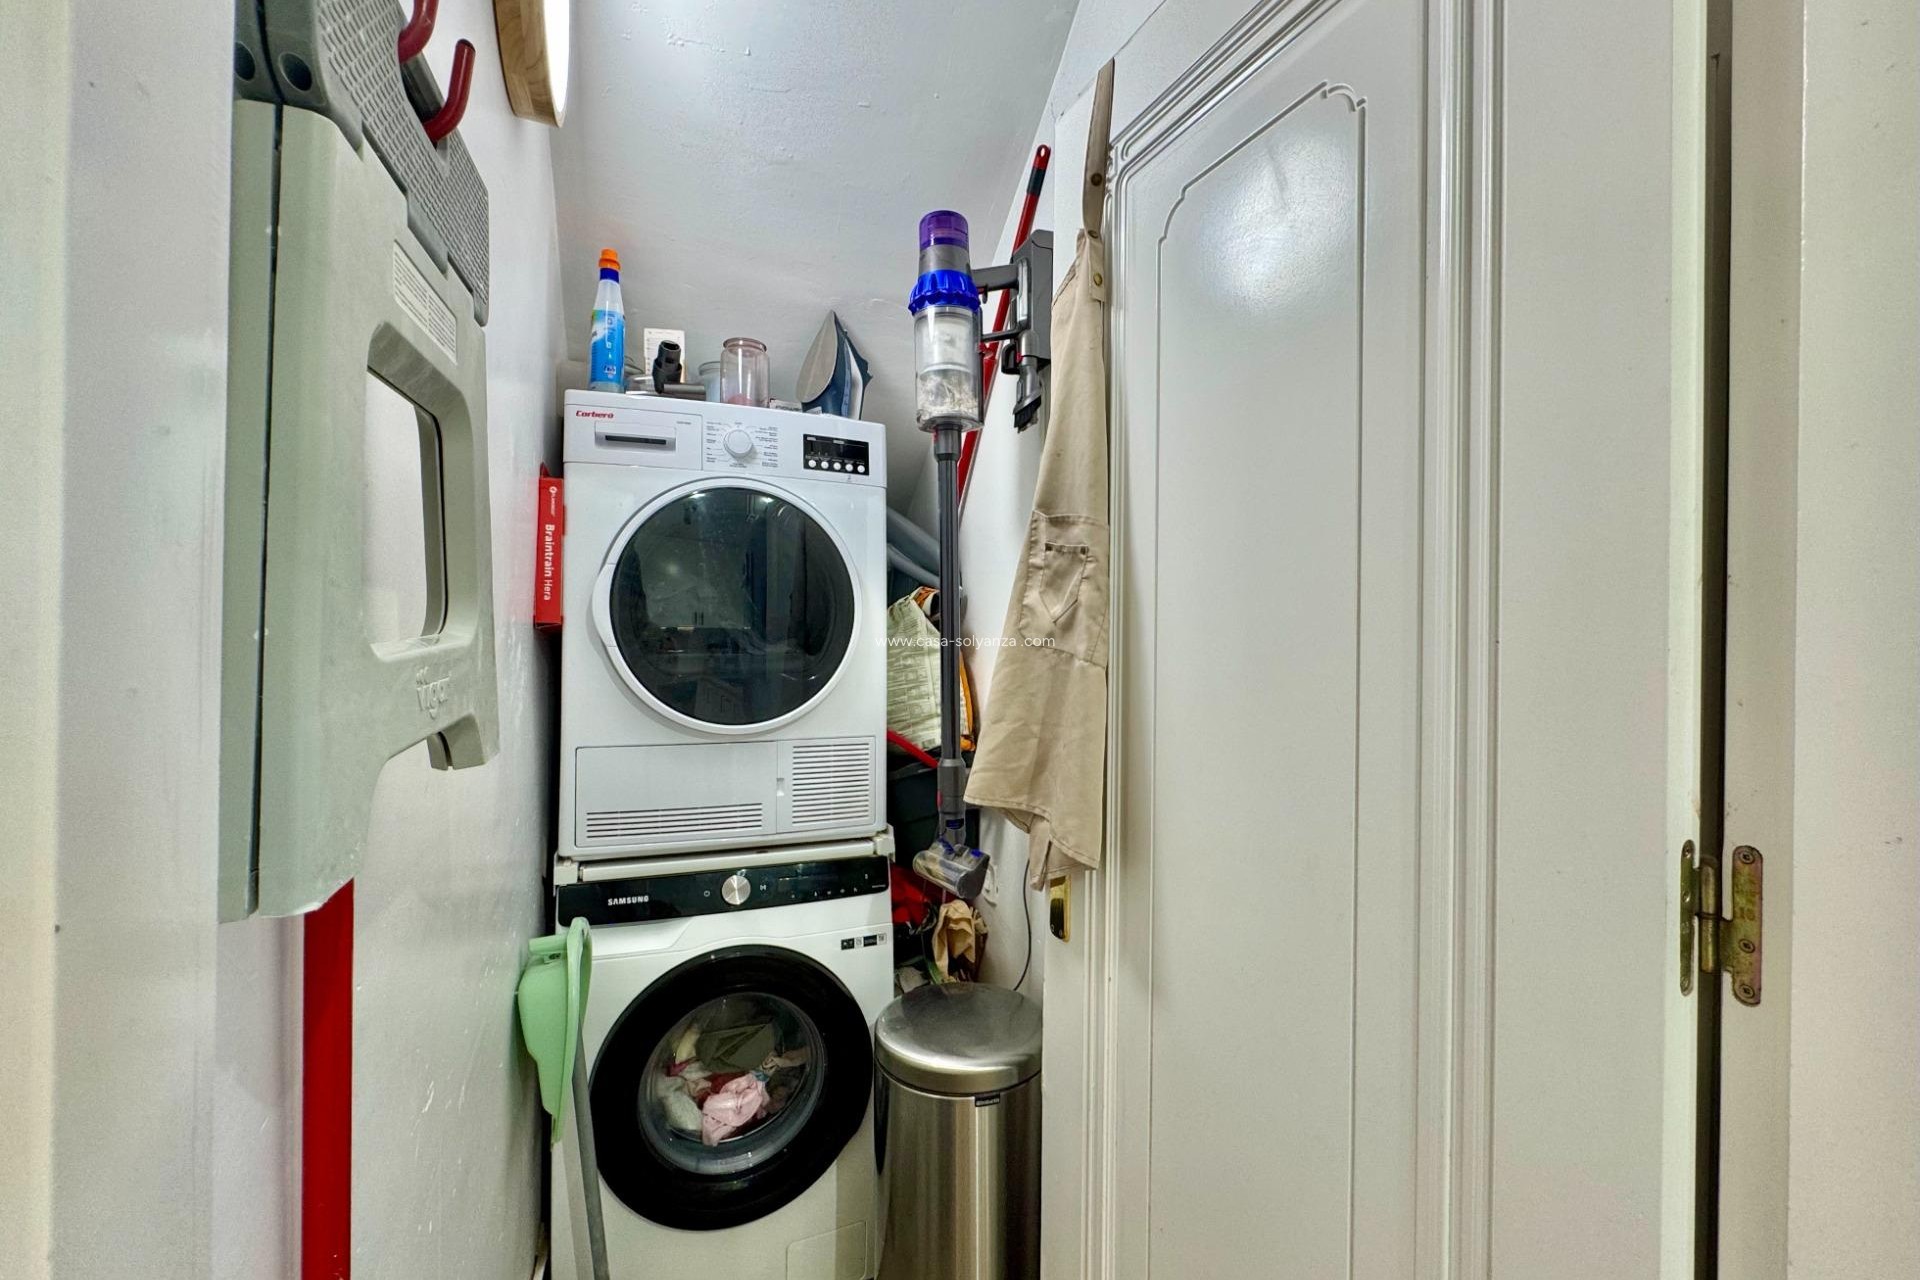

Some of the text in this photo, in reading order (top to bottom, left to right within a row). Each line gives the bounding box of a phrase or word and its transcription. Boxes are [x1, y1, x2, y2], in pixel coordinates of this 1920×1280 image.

[544, 523, 556, 577] Braintrain
[543, 579, 553, 601] Hera
[607, 895, 650, 907] SAMSUNG
